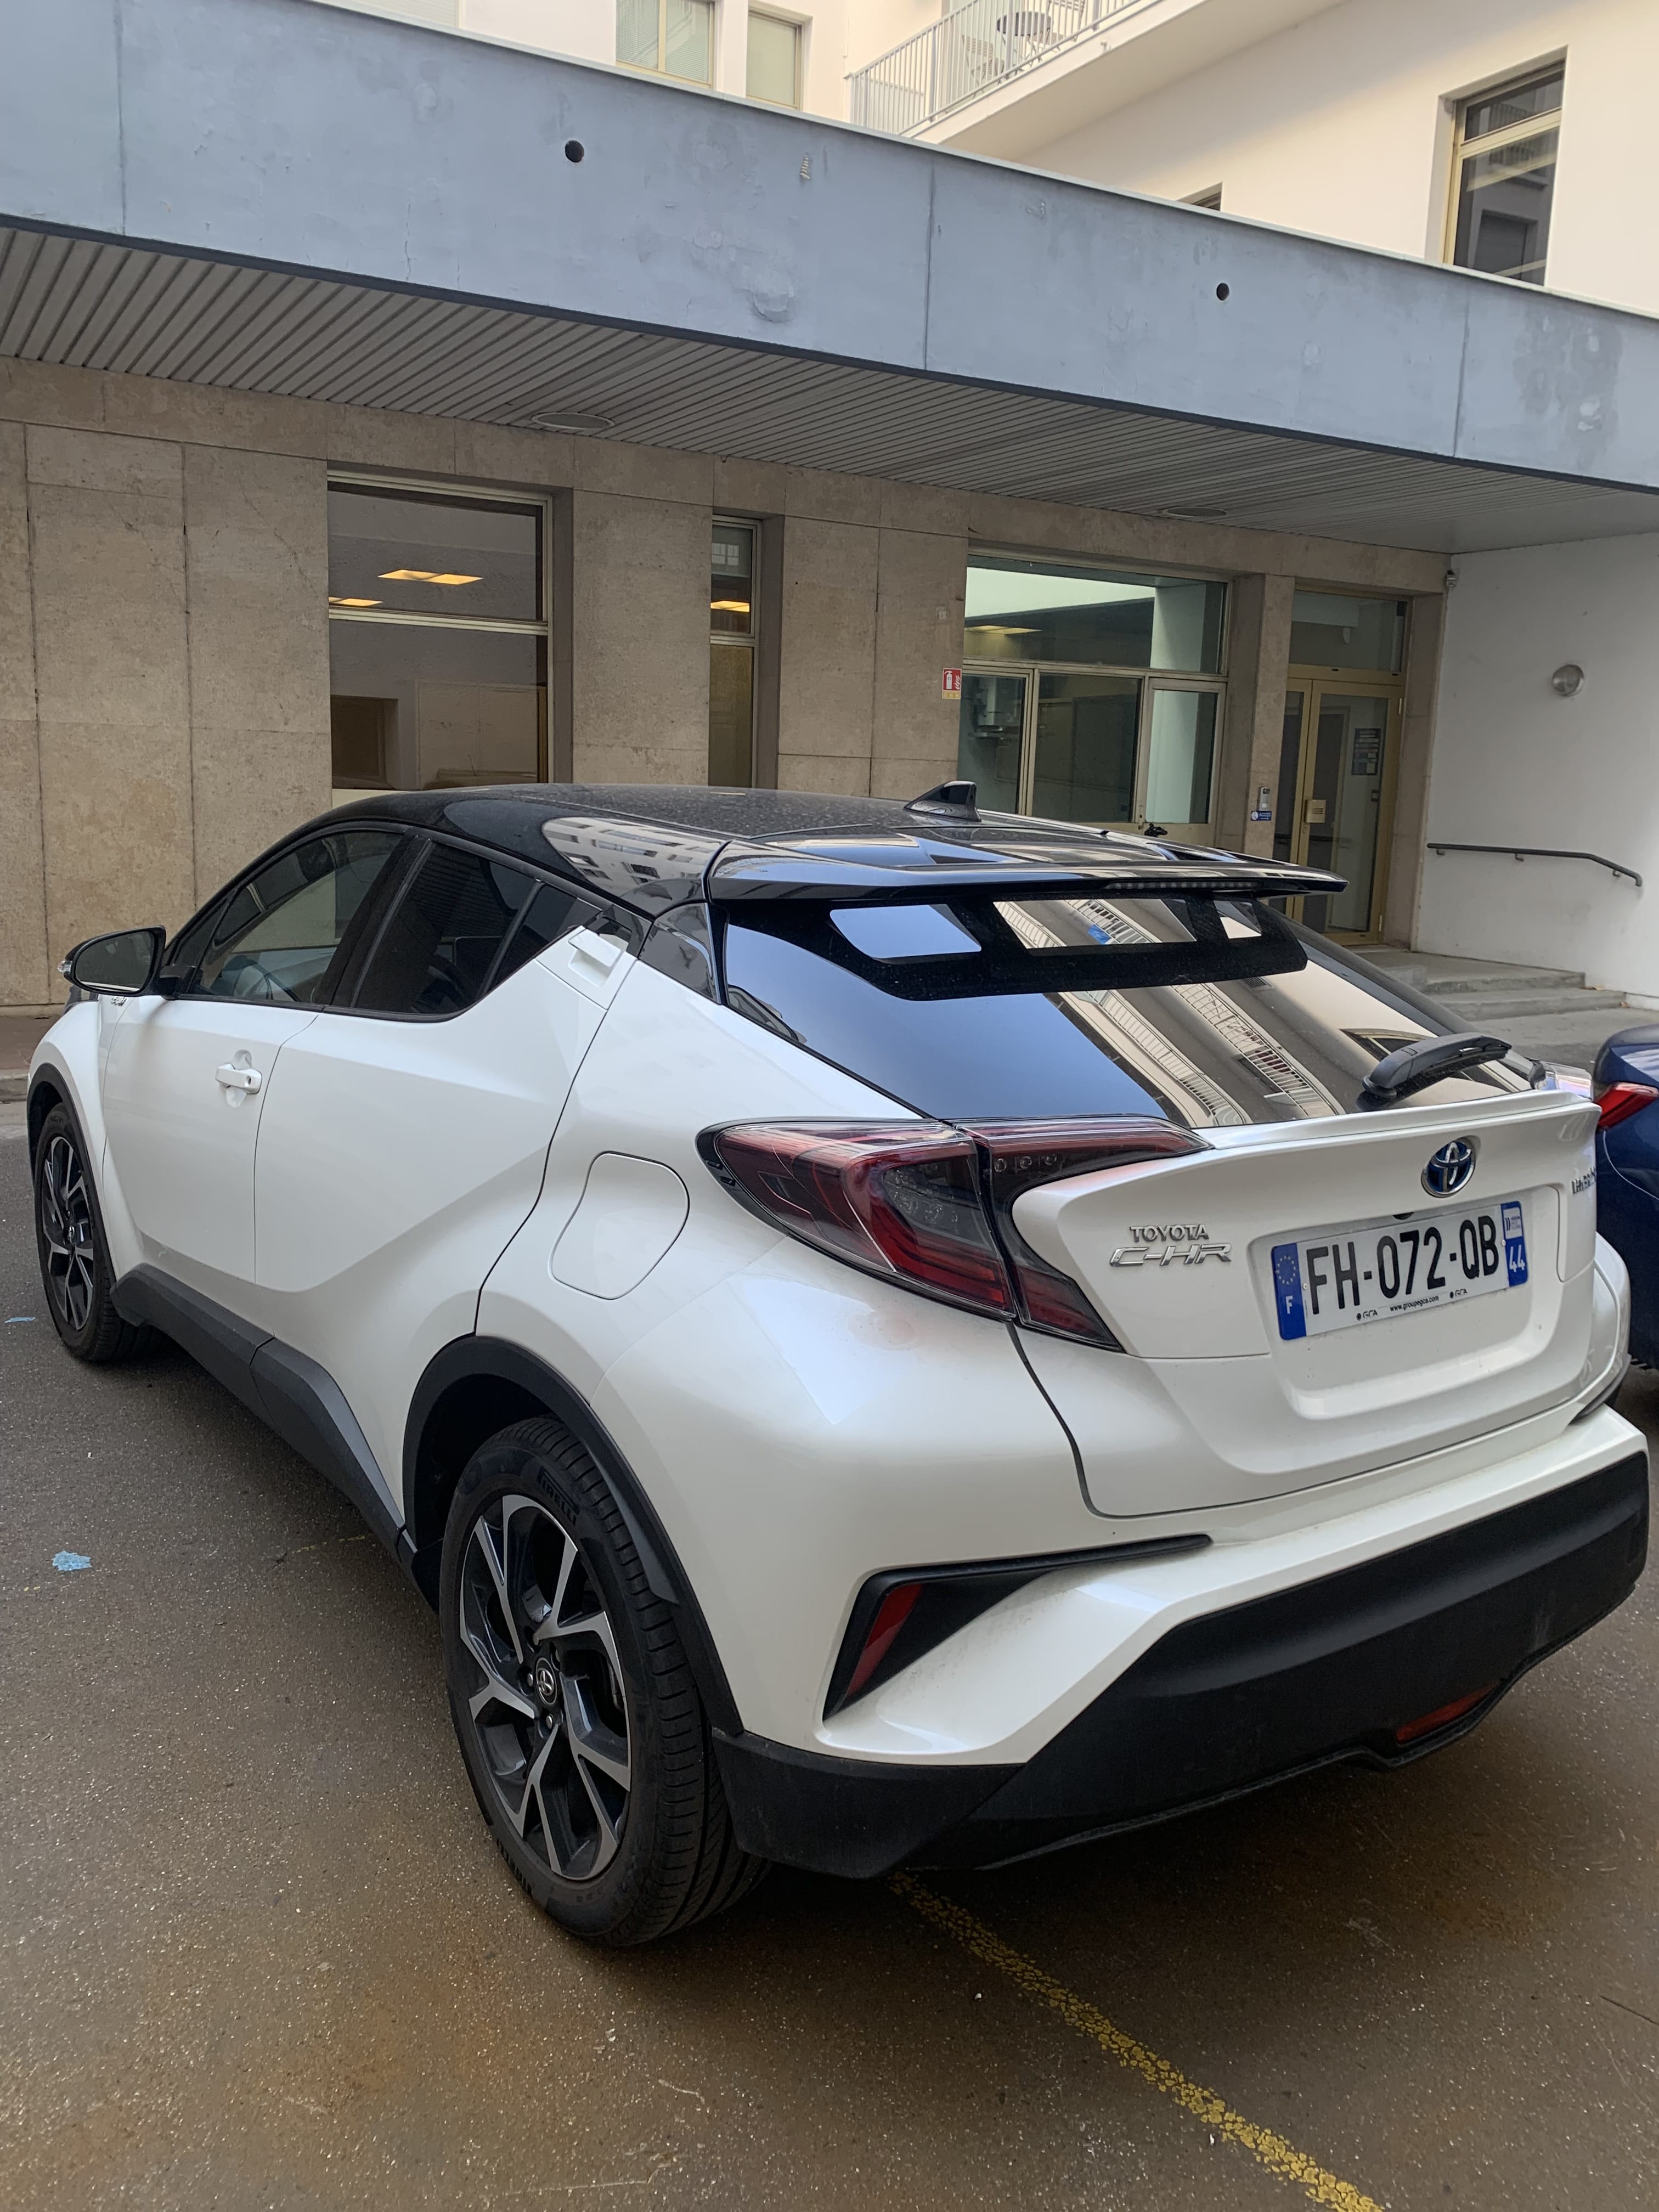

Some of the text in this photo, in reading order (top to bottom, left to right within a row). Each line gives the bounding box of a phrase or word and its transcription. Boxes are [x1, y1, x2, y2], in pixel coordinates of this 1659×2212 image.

[1129, 1224, 1209, 1242] TOYOTA
[1109, 1243, 1232, 1267] C-HR
[1306, 1215, 1499, 1314] FH-072-QB
[1509, 1245, 1526, 1272] 44
[1285, 1295, 1294, 1314] F
[1390, 1295, 1440, 1312] www.groupegca.com
